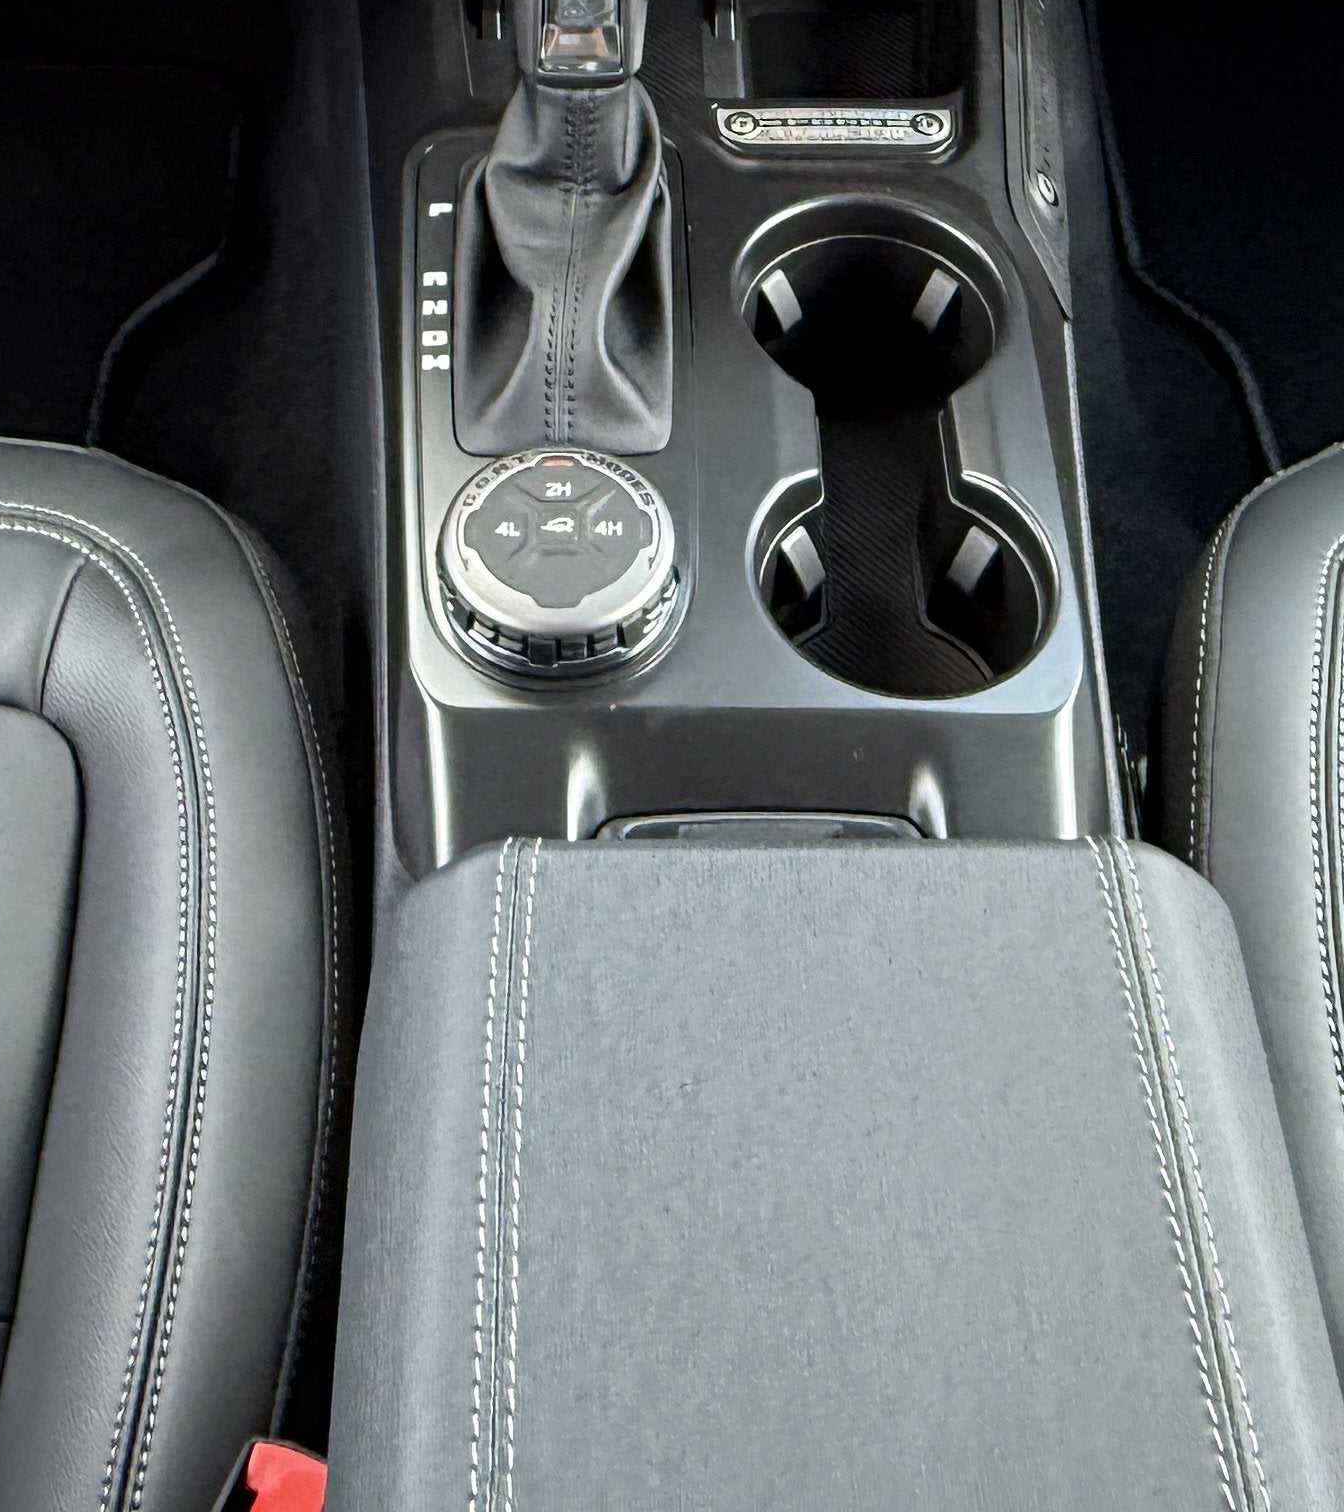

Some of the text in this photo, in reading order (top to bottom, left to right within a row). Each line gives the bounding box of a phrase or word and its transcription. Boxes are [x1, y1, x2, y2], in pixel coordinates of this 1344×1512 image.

[428, 202, 454, 218] P
[422, 299, 448, 316] N
[544, 481, 572, 498] 2H
[493, 521, 521, 538] 4L
[593, 520, 624, 537] 4H
